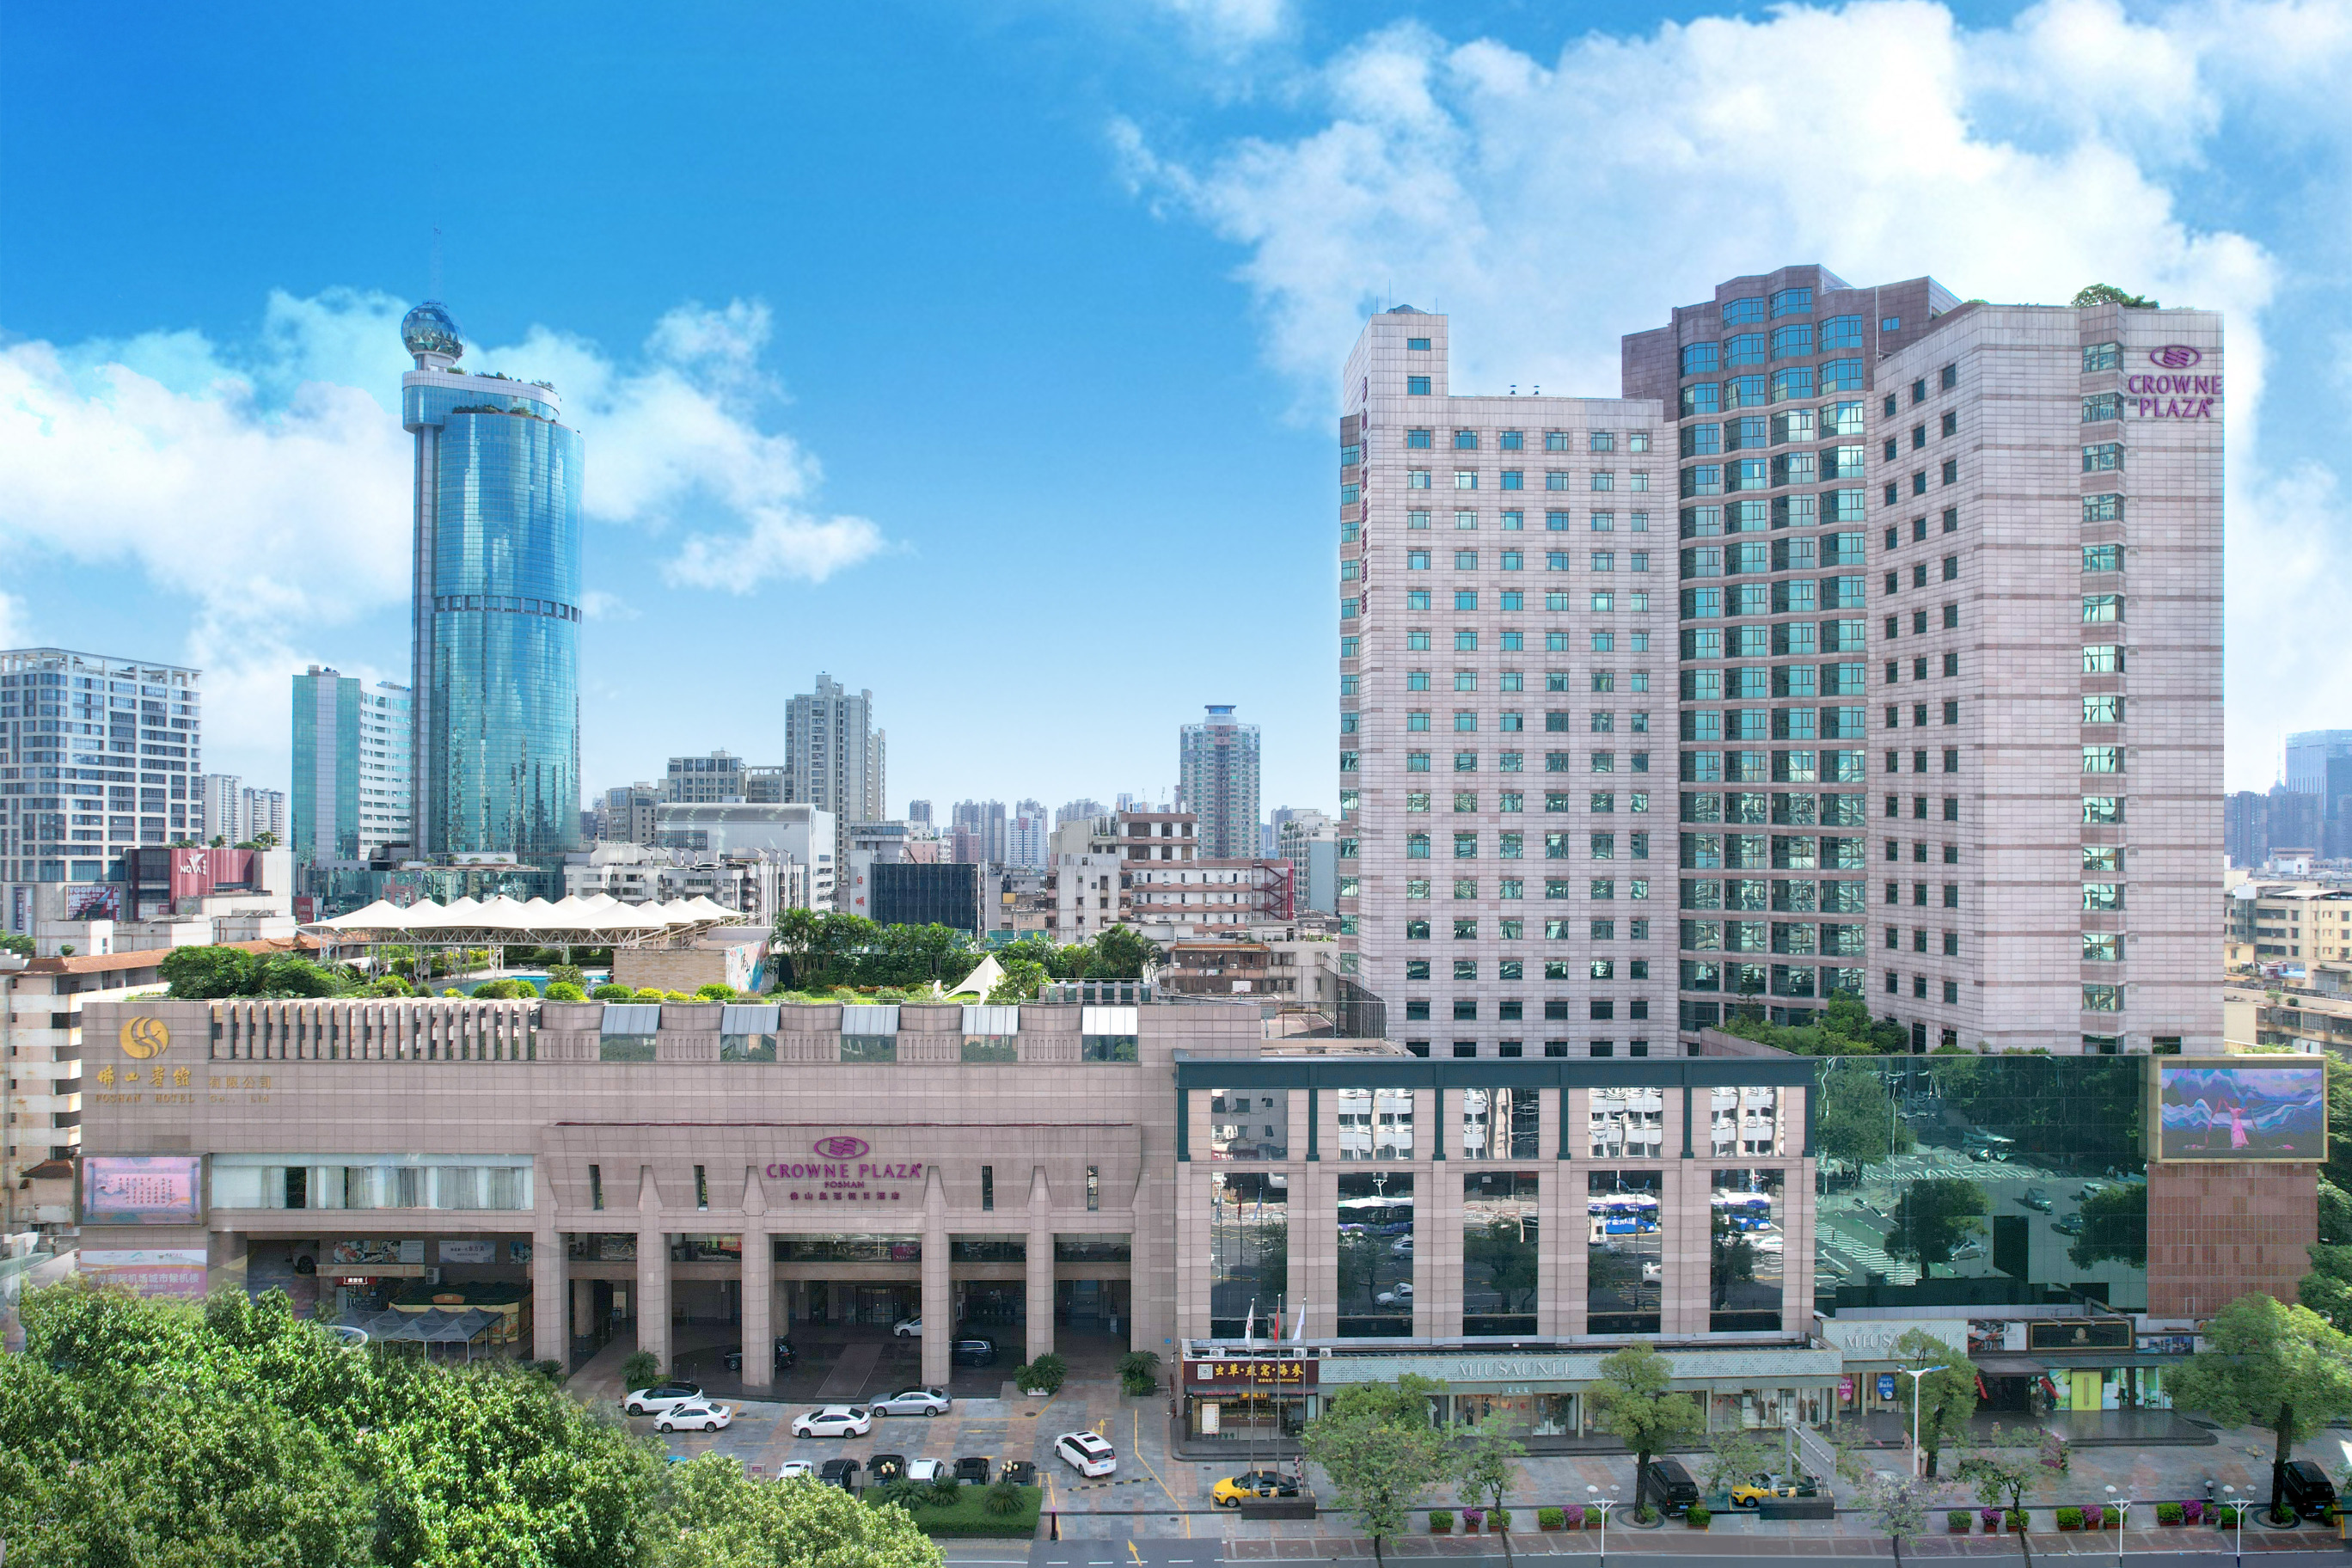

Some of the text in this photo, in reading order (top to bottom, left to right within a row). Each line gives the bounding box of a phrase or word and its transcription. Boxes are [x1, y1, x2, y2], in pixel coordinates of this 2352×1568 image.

[2128, 375, 2222, 395] CROWNE
[2140, 398, 2211, 418] PLAZA
[180, 854, 205, 874] NOVA
[209, 1076, 271, 1089] 有限公司
[95, 1093, 141, 1103] FOSHAN
[156, 1093, 194, 1103] HOTEL
[767, 1163, 922, 1179] CROWNE PLAZA
[824, 1180, 865, 1189] FOSHAN
